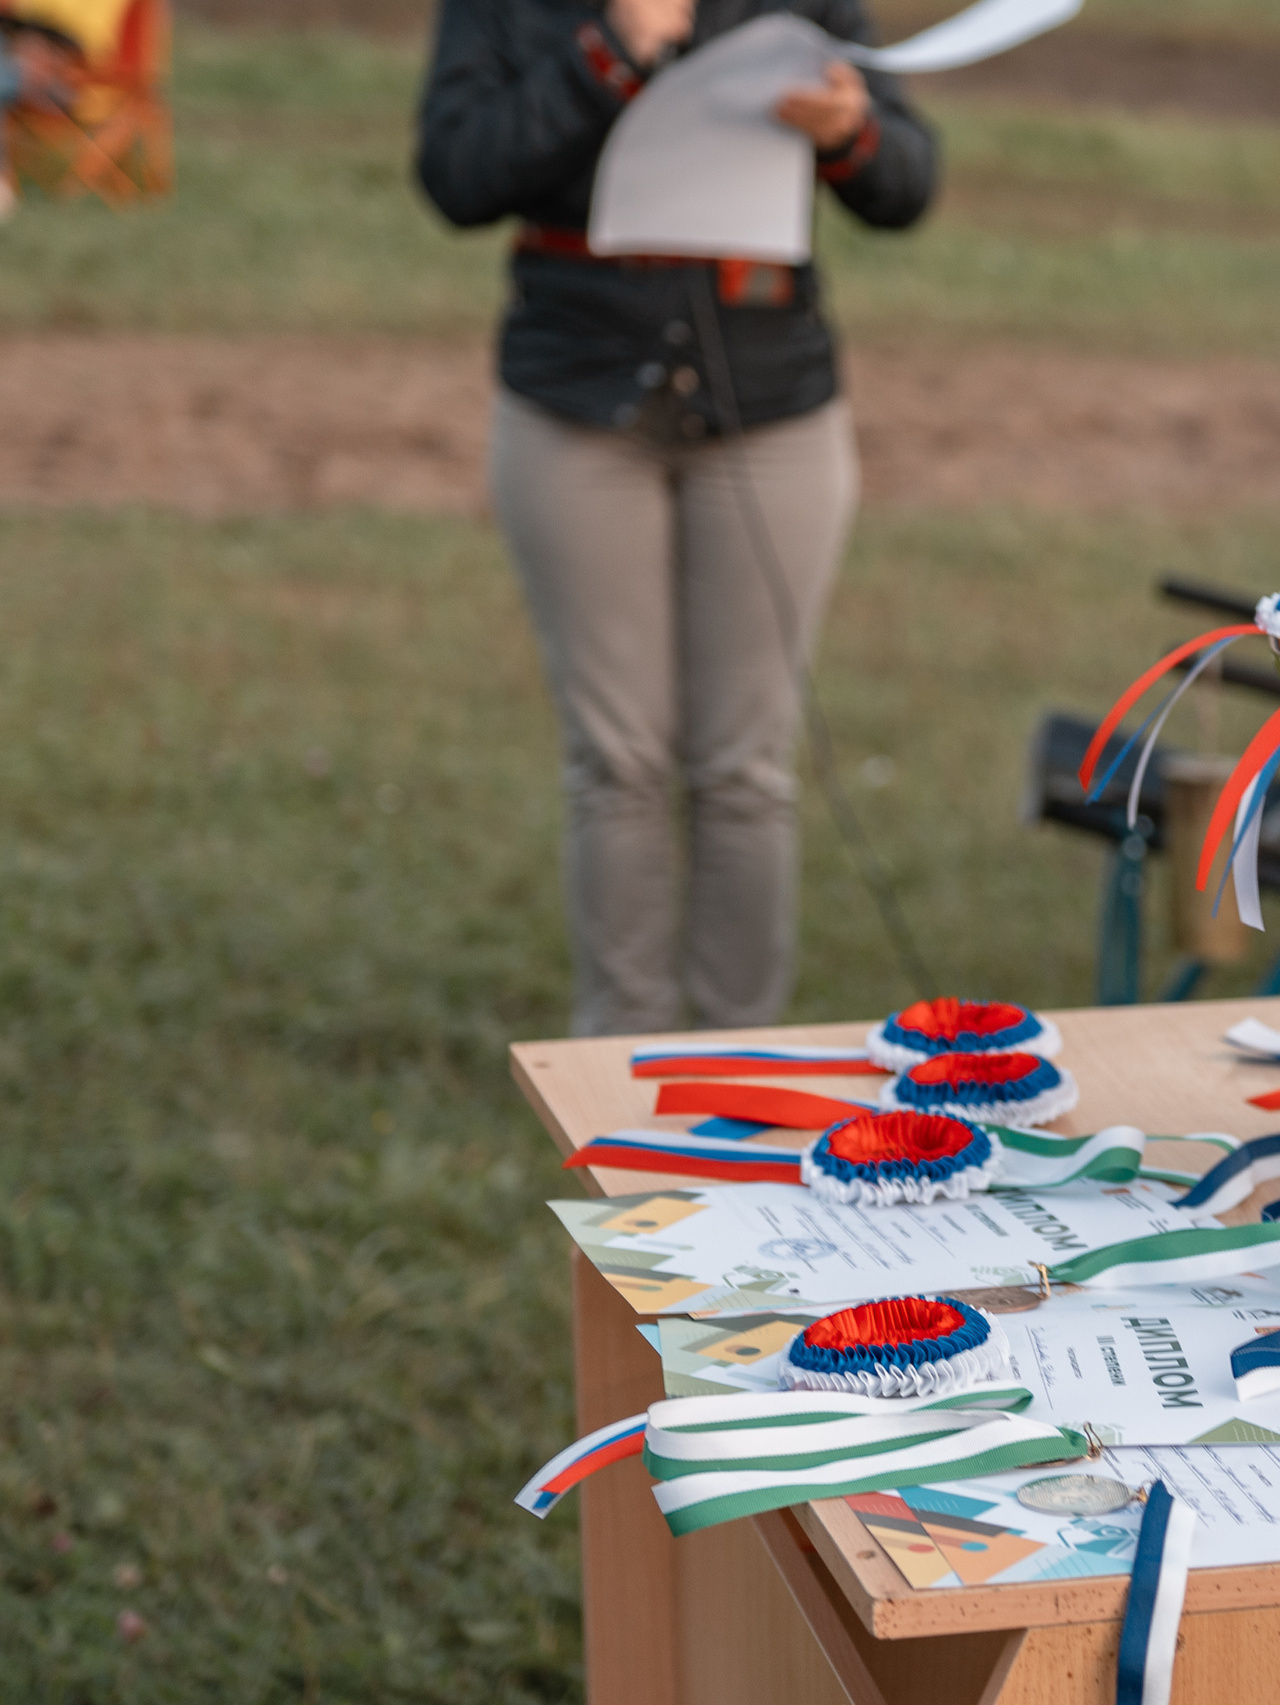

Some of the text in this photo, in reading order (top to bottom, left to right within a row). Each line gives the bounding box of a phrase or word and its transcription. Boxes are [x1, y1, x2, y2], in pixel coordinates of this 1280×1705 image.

[983, 1187, 1089, 1251] ИПЛОМ
[1100, 1346, 1127, 1387] степени
[1120, 1316, 1204, 1409] ДИПЛОМ
